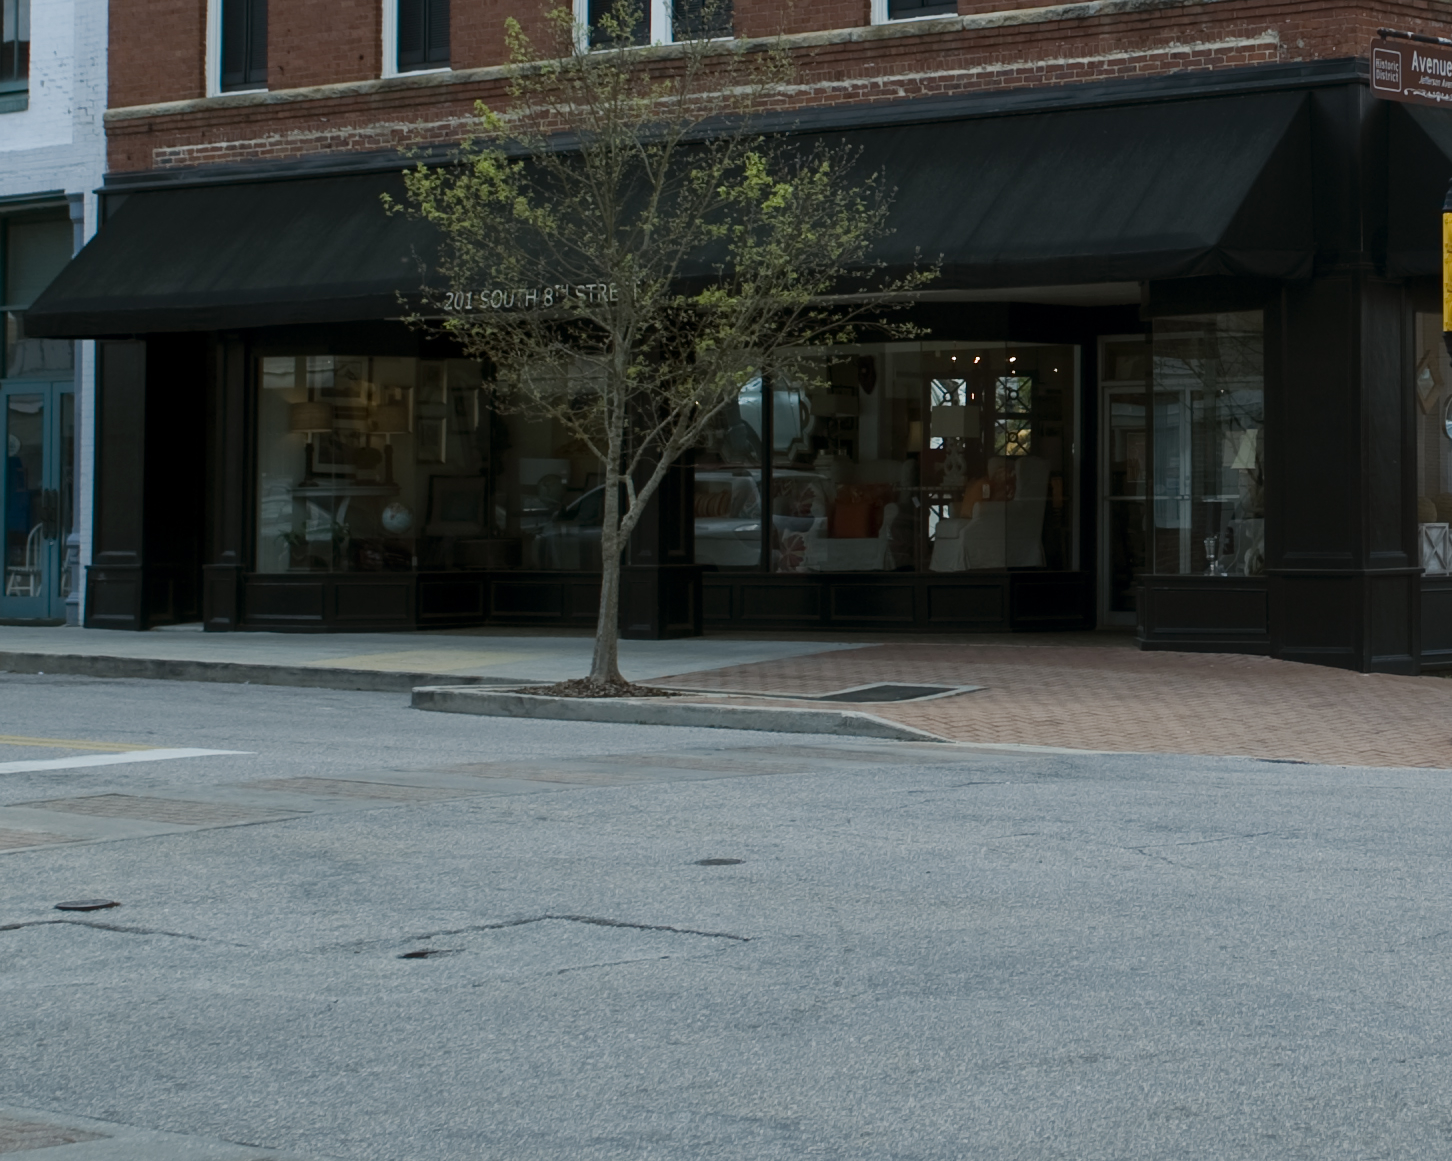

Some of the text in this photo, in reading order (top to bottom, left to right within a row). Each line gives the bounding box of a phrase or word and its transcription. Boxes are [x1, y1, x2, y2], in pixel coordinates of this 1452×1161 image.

[1375, 58, 1399, 72] Historic
[1411, 50, 1452, 77] Avenue
[1375, 69, 1399, 83] District
[1418, 75, 1441, 86] Jefferson
[444, 291, 473, 310] 201
[575, 281, 641, 304] STRET
